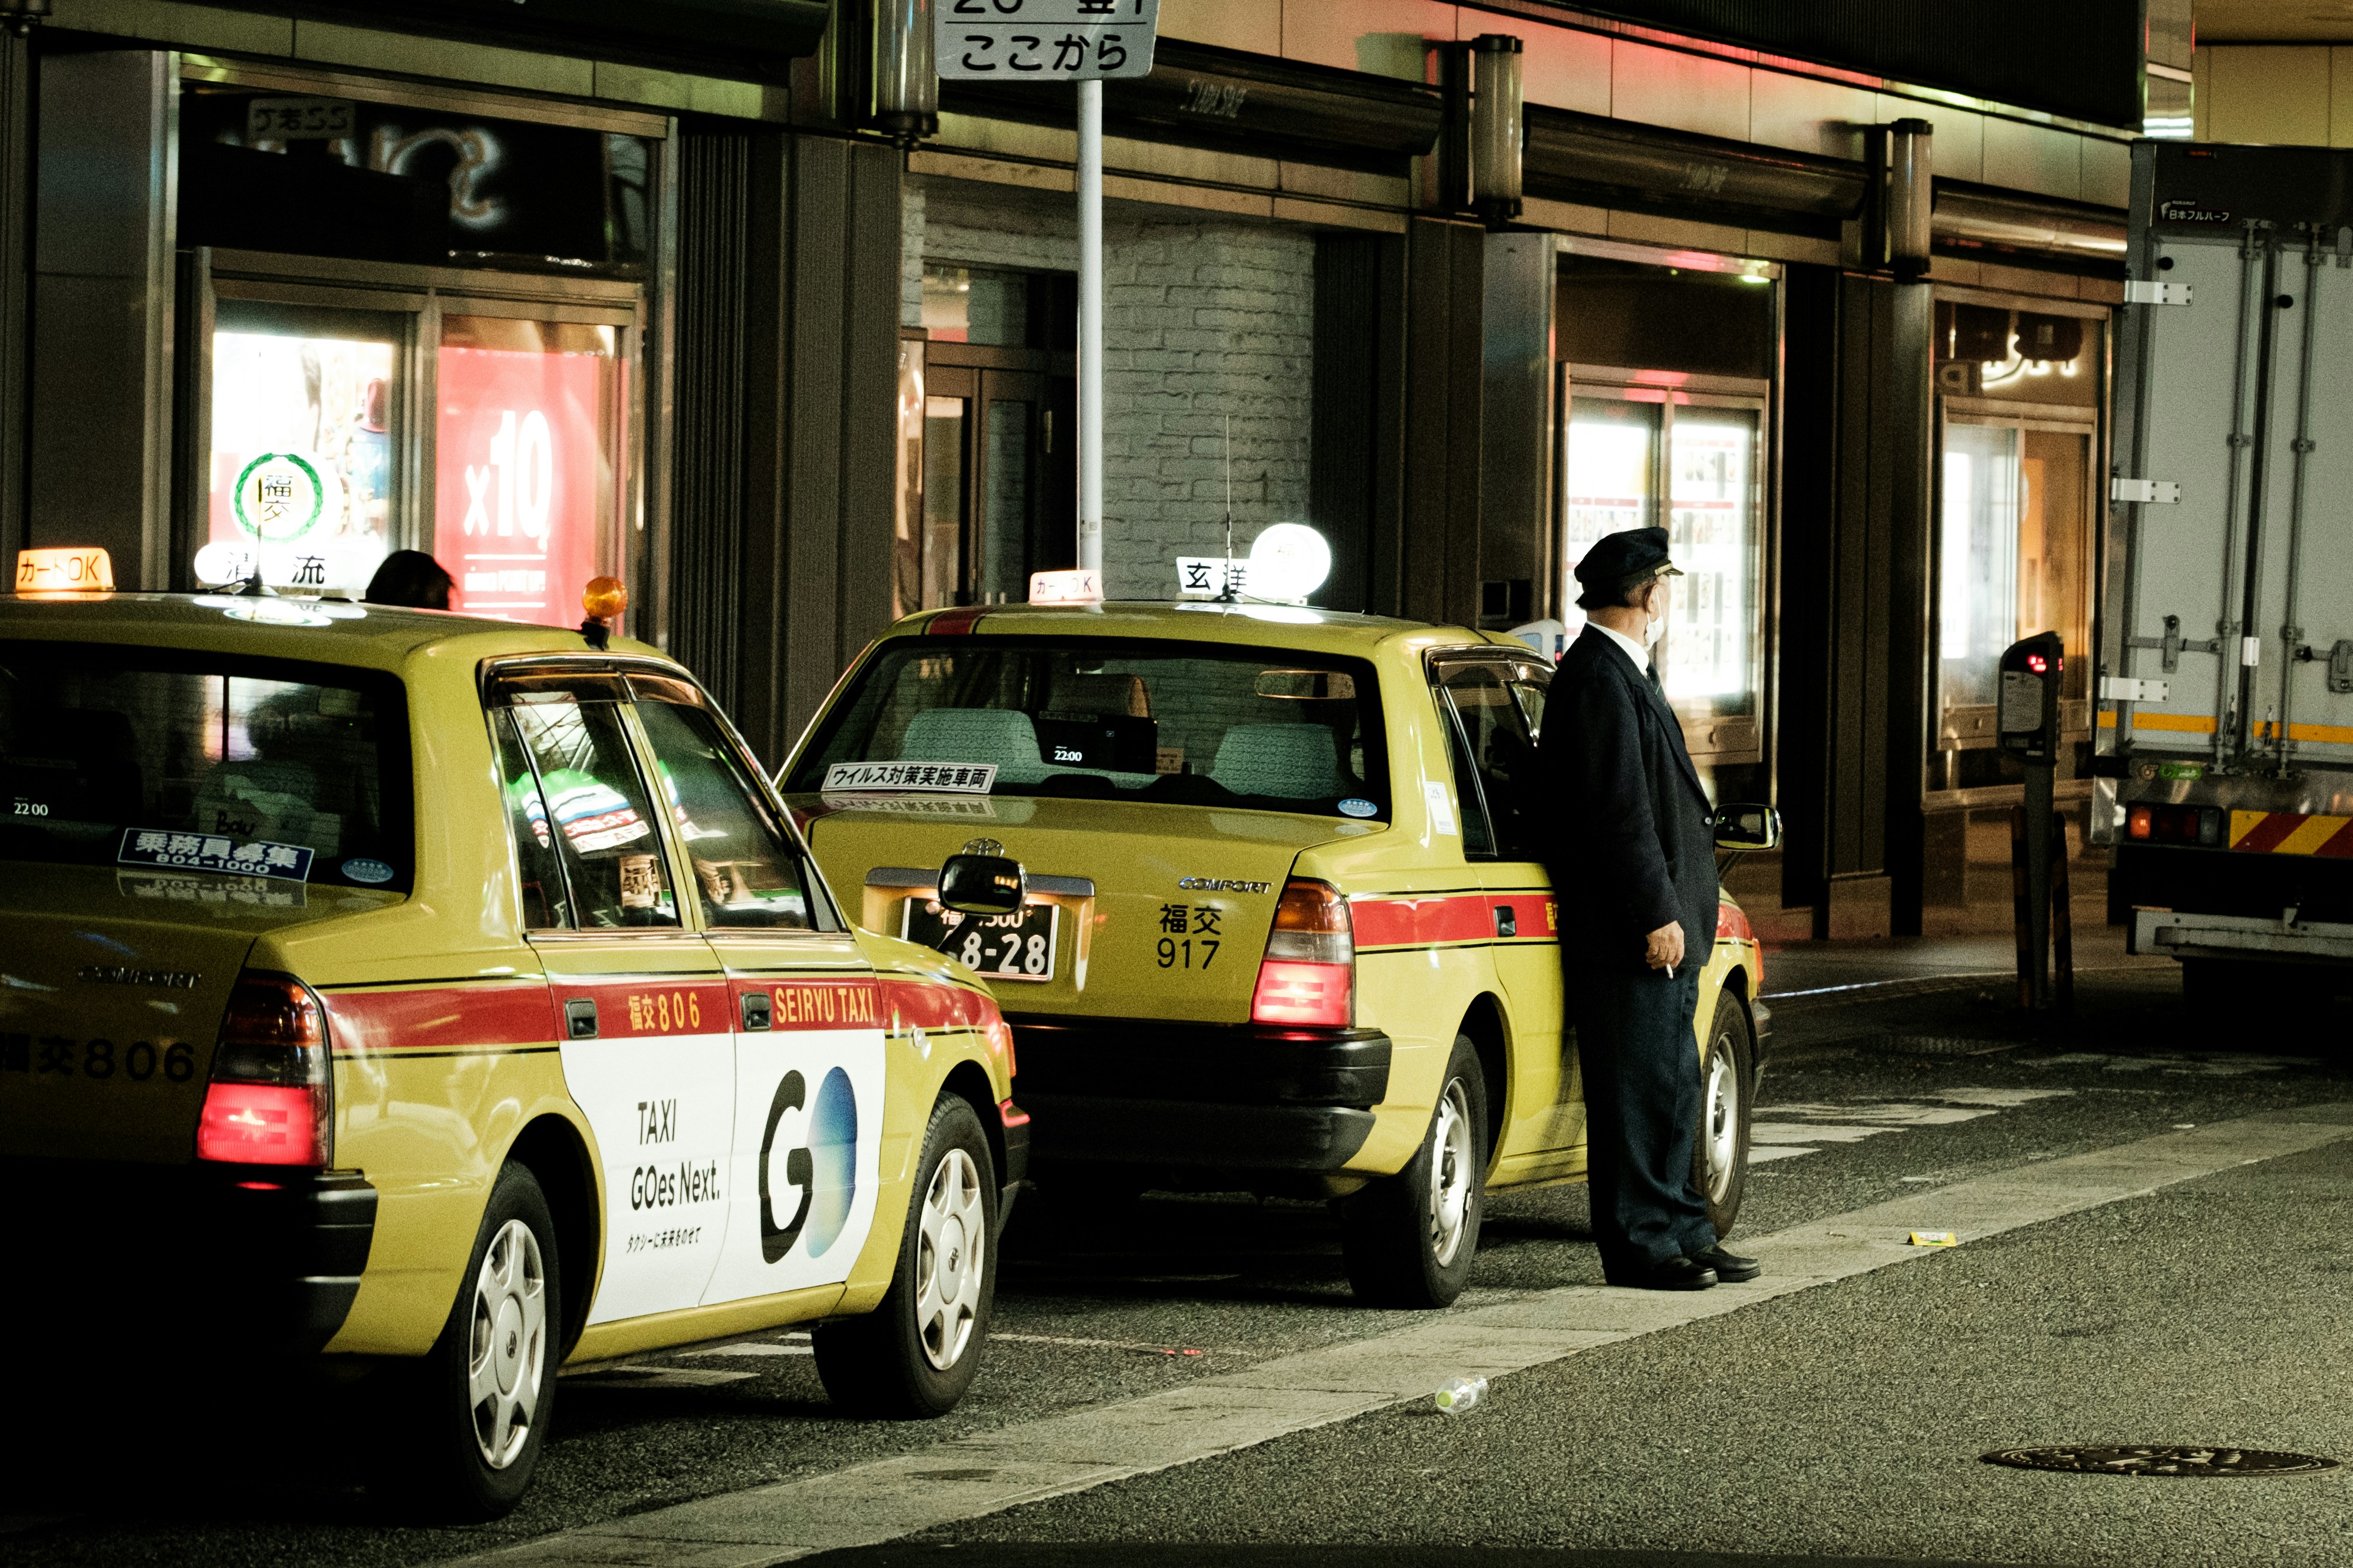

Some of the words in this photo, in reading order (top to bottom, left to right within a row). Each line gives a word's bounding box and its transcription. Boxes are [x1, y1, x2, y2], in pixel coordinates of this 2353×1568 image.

[962, 34, 1126, 71] ここから
[2169, 209, 2230, 222] 日本フルハーフ
[833, 765, 989, 788] ウイルス対策実施車両
[156, 853, 271, 874] 804-1000
[1179, 876, 1274, 894] COMFORT
[1159, 903, 1222, 936] 福交
[943, 929, 1046, 973] 8-28
[1157, 938, 1220, 970] 917
[775, 987, 835, 1024] SEIRYU
[838, 988, 875, 1022] TAXI
[638, 1098, 676, 1145] TAXI
[631, 1165, 675, 1211] GOes
[679, 1159, 720, 1204] Next.
[626, 1226, 702, 1253] タクシーに未来をのせて
